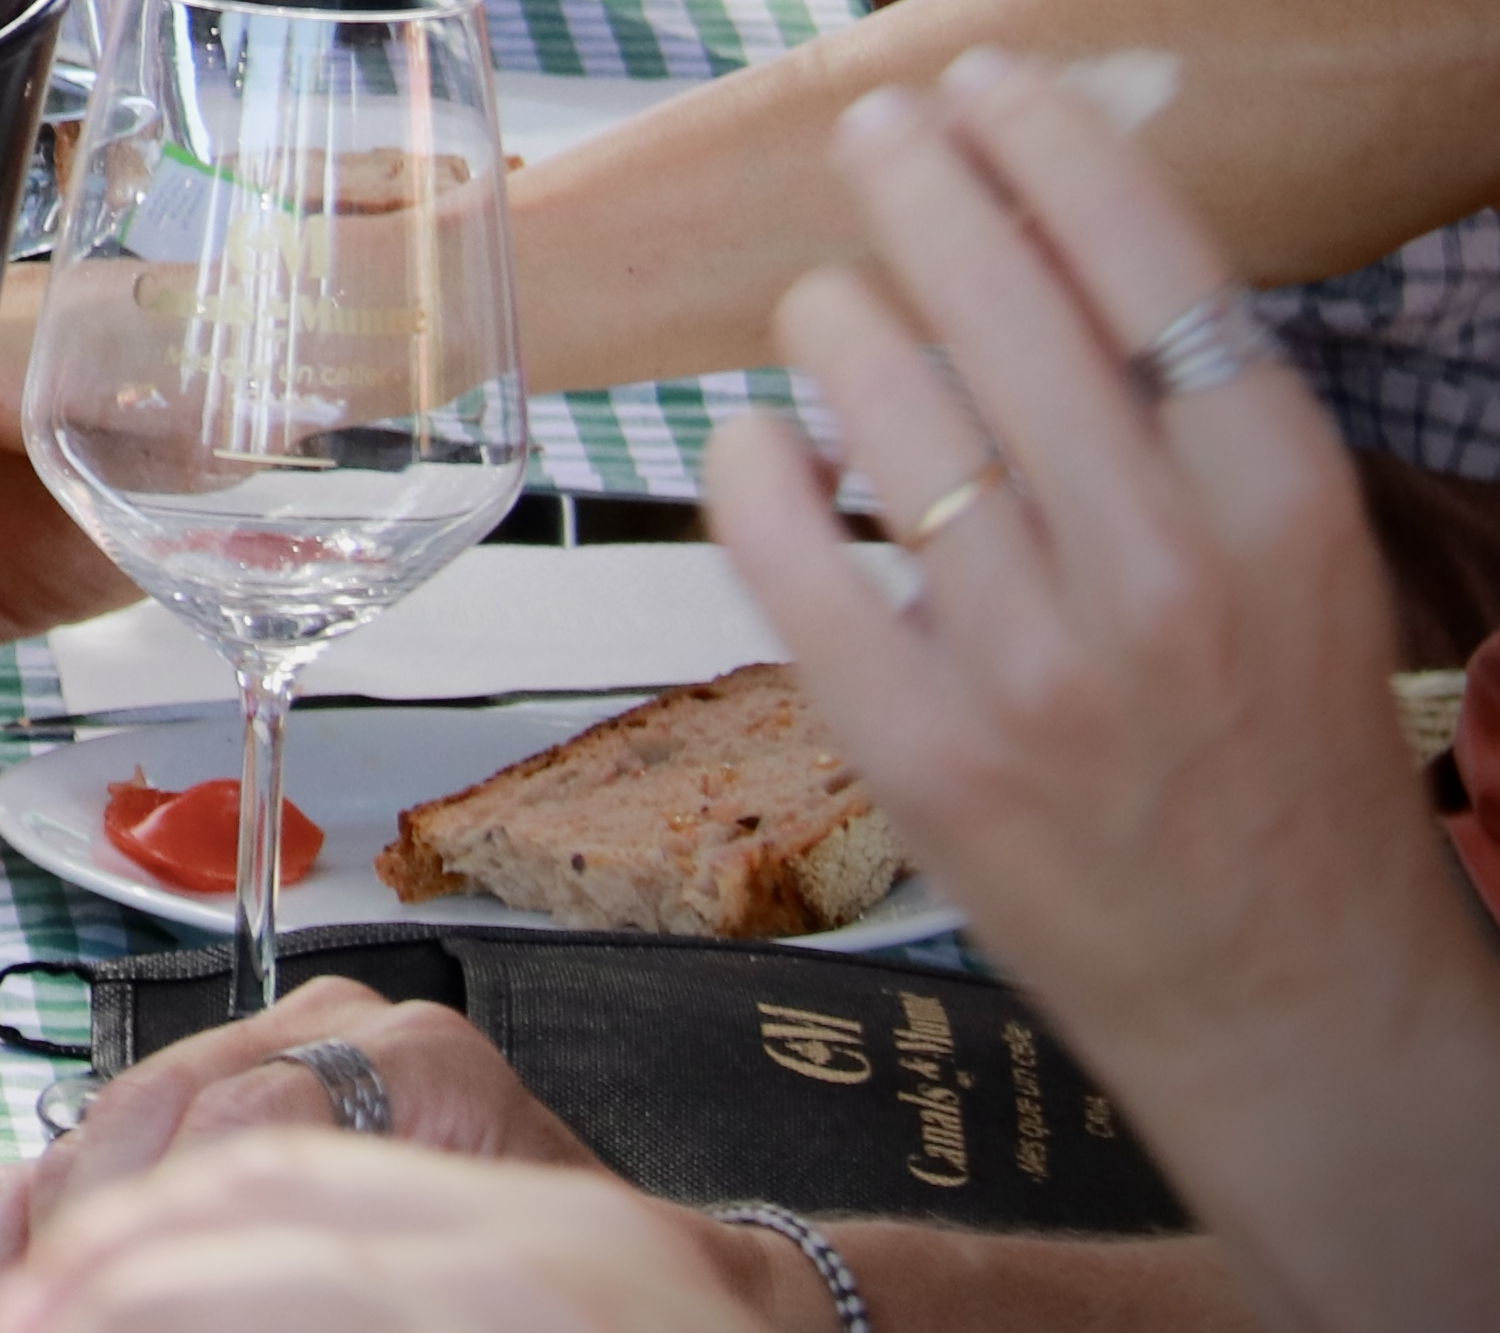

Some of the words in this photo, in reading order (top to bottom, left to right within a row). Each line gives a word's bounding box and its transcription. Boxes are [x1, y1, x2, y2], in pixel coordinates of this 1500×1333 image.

[1012, 1068, 1042, 1098] un
[896, 1083, 970, 1187] Canals
[1015, 1098, 1053, 1139] que
